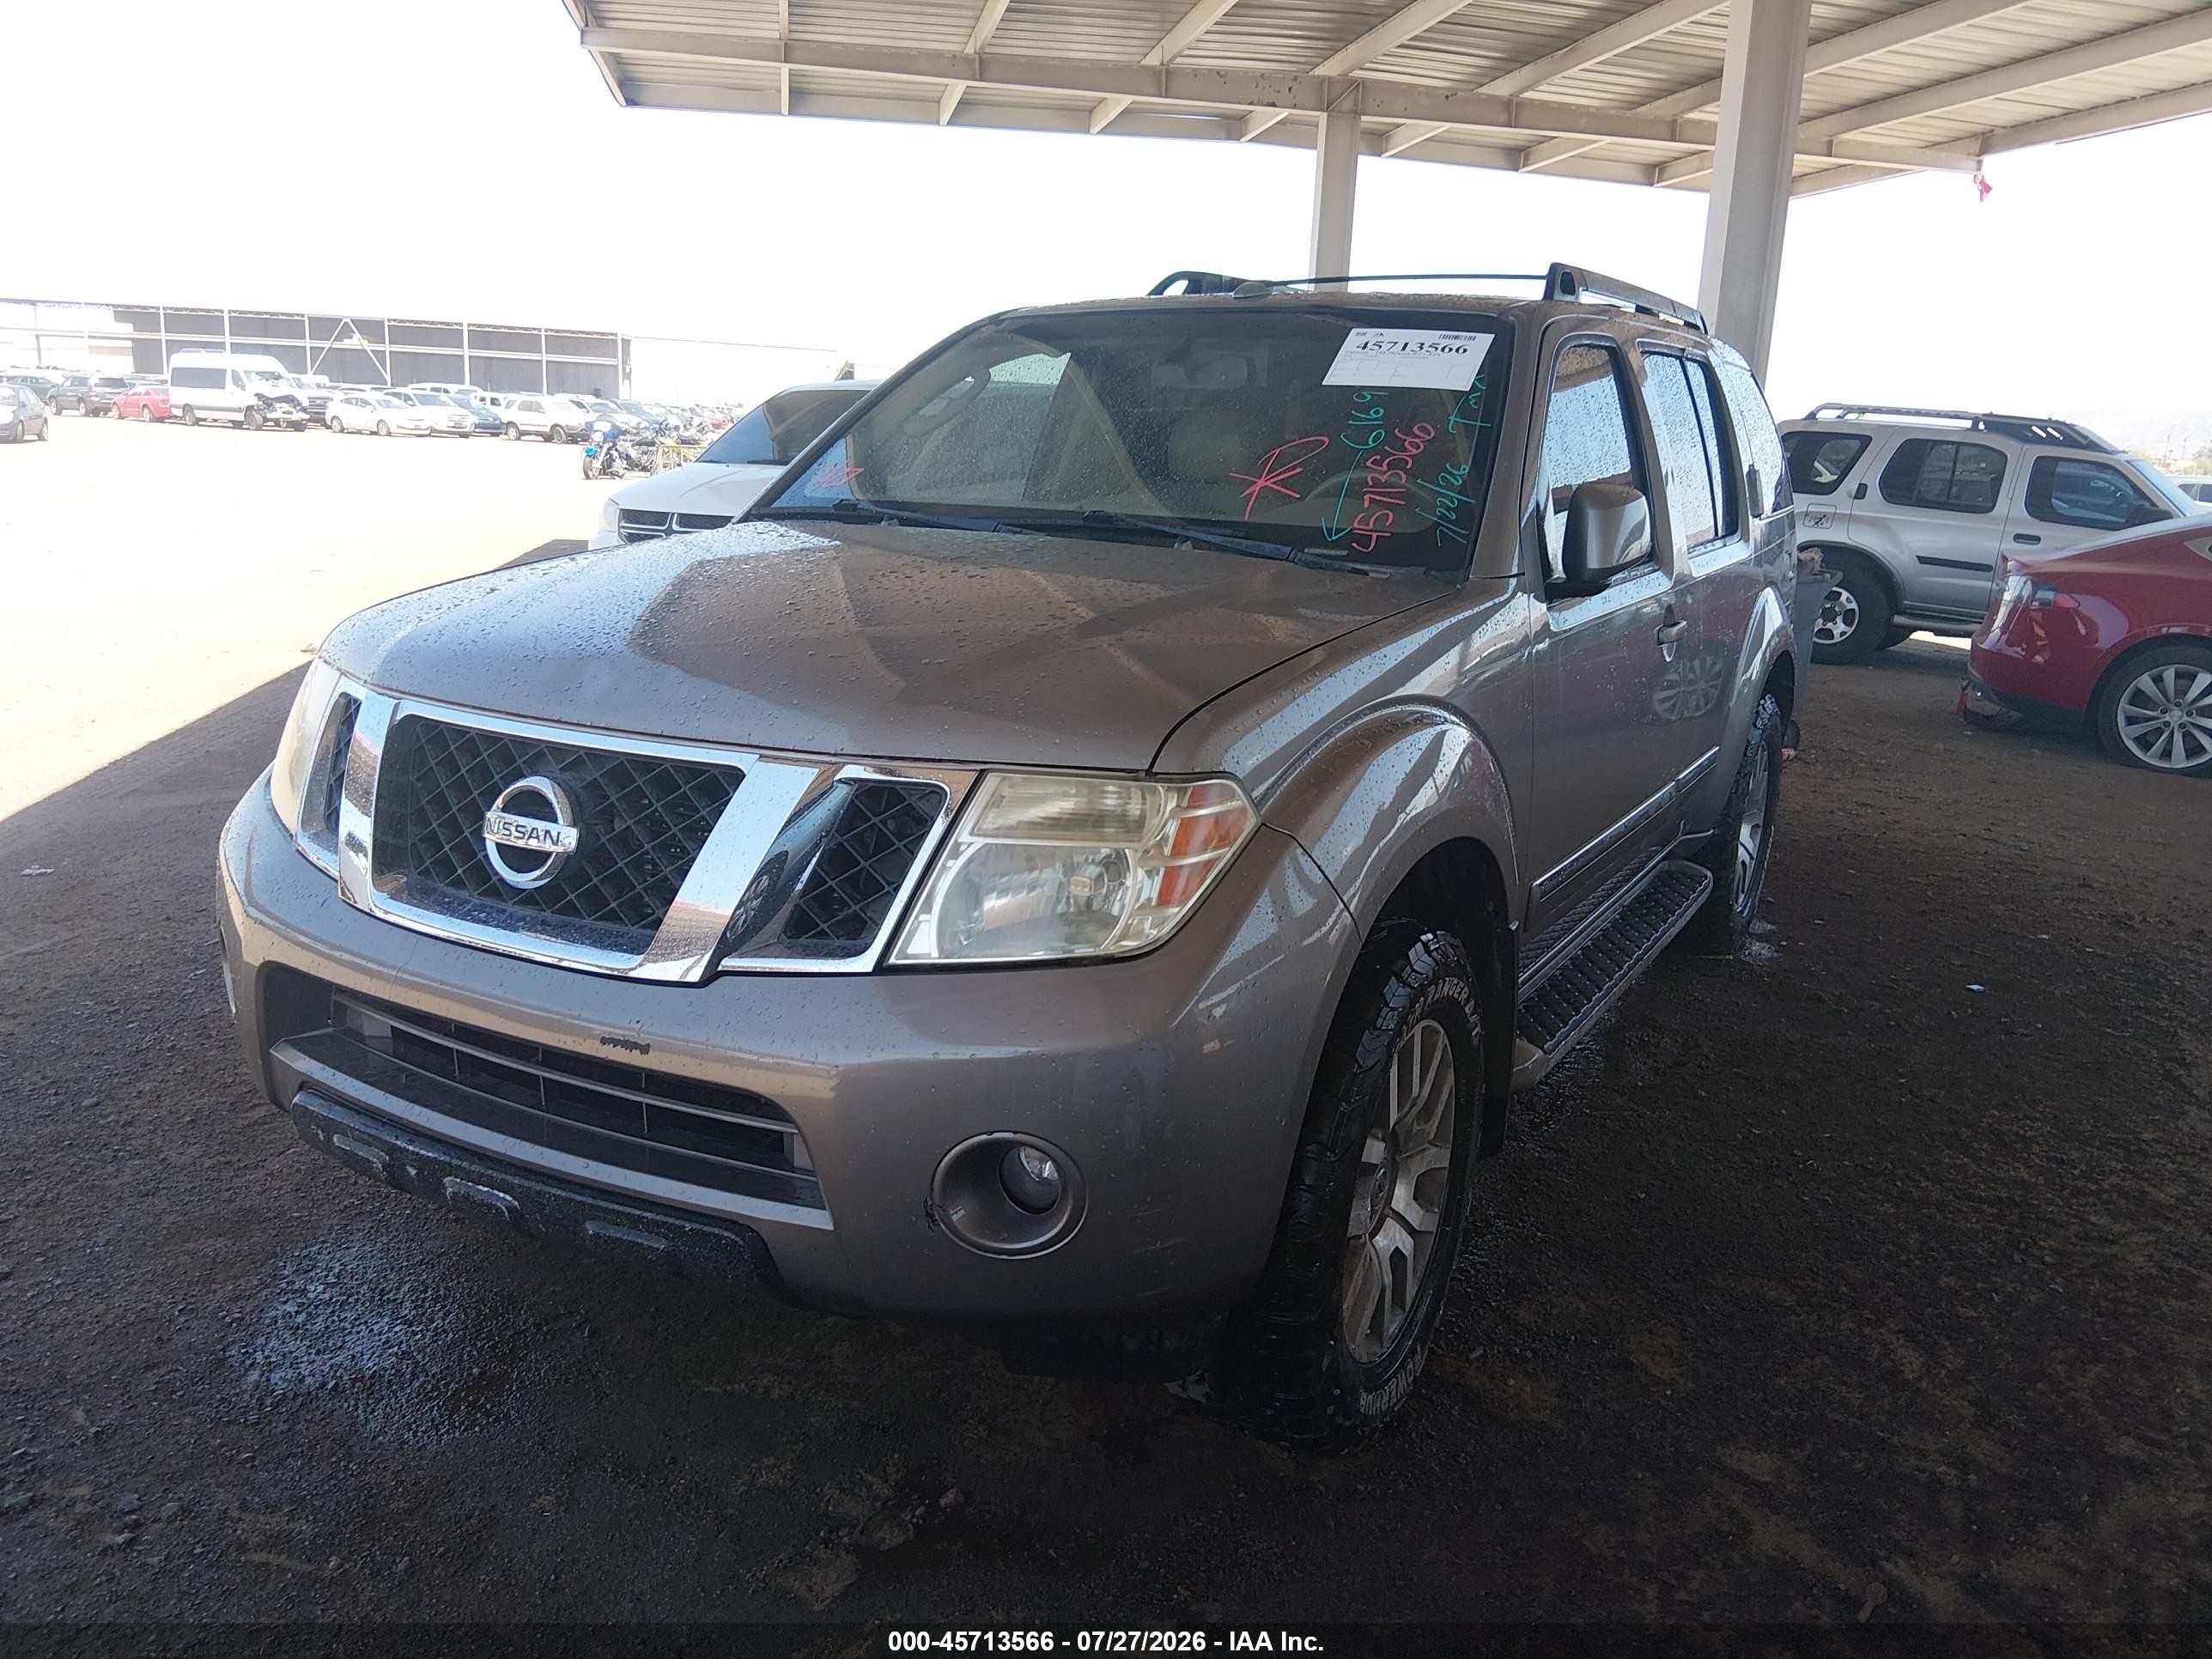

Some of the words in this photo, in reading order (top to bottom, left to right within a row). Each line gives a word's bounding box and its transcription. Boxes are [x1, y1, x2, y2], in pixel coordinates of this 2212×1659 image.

[1355, 340, 1470, 355] 45713566
[1351, 422, 1435, 553] 45713566
[485, 817, 562, 847] NISSAN
[1425, 976, 1470, 1011] RANGER
